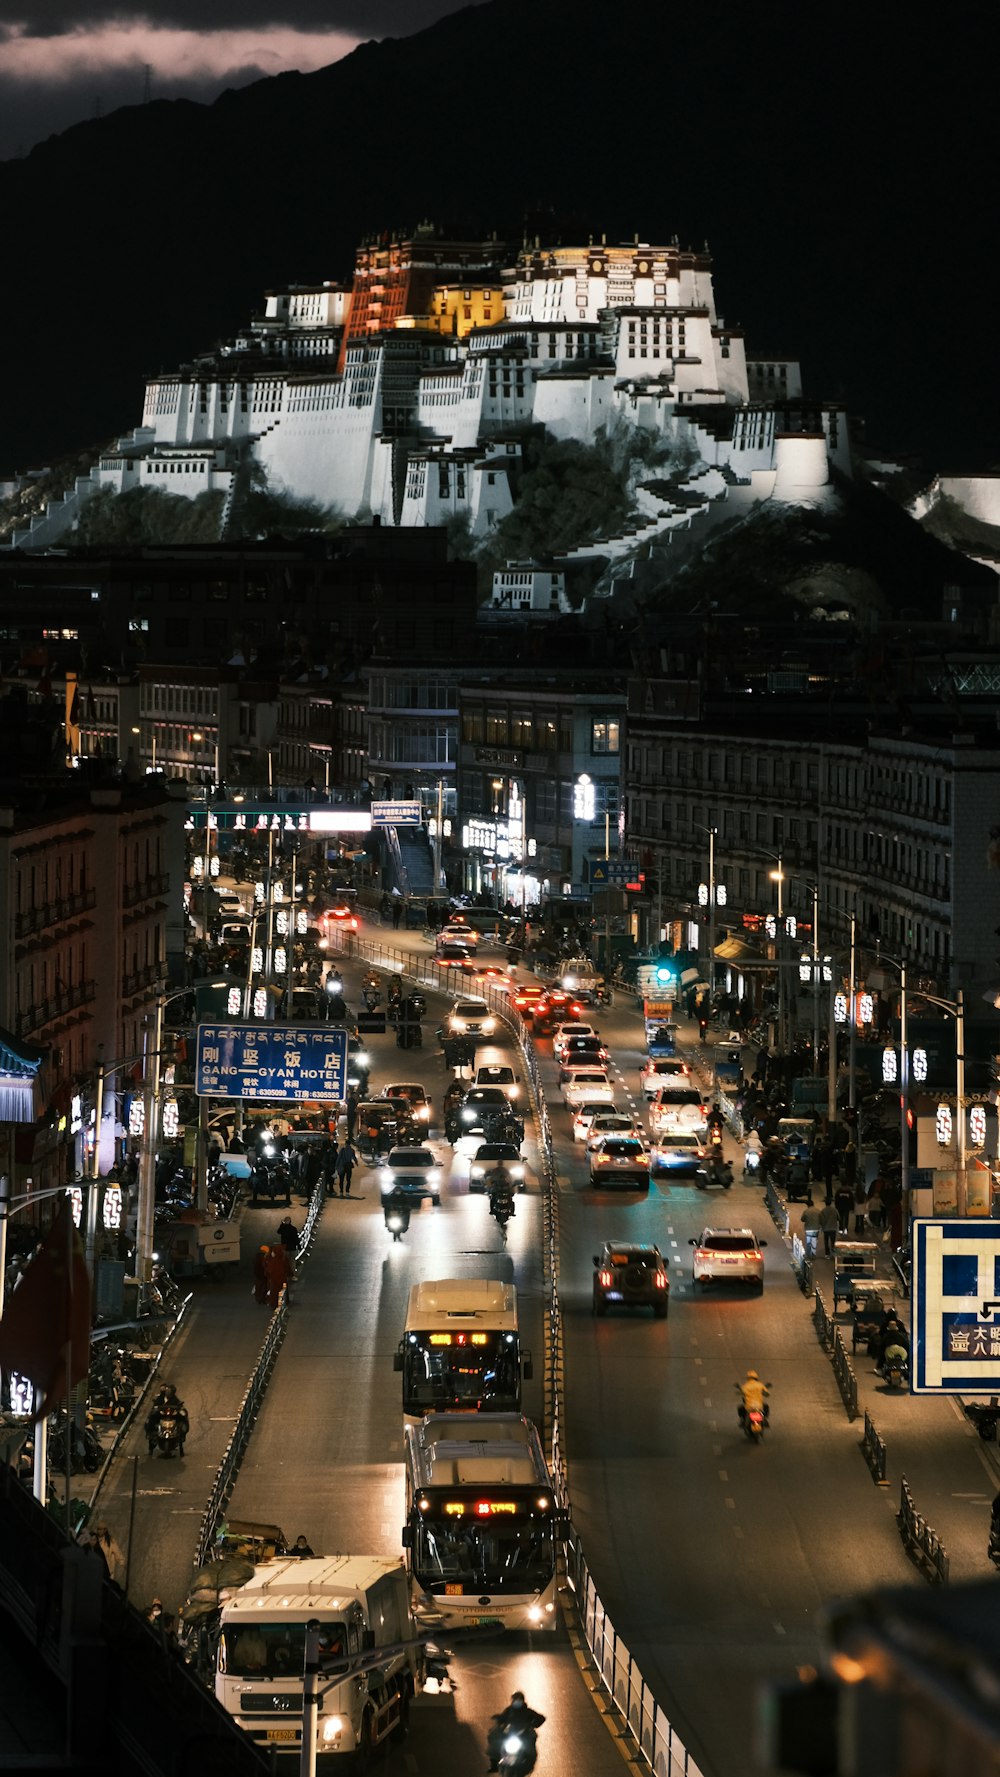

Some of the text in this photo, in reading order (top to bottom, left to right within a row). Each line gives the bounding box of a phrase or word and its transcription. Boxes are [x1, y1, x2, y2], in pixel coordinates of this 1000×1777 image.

[202, 1047, 341, 1070] 刚坚饭店
[300, 1069, 341, 1080] HOTEL
[202, 1076, 218, 1085] 住宿
